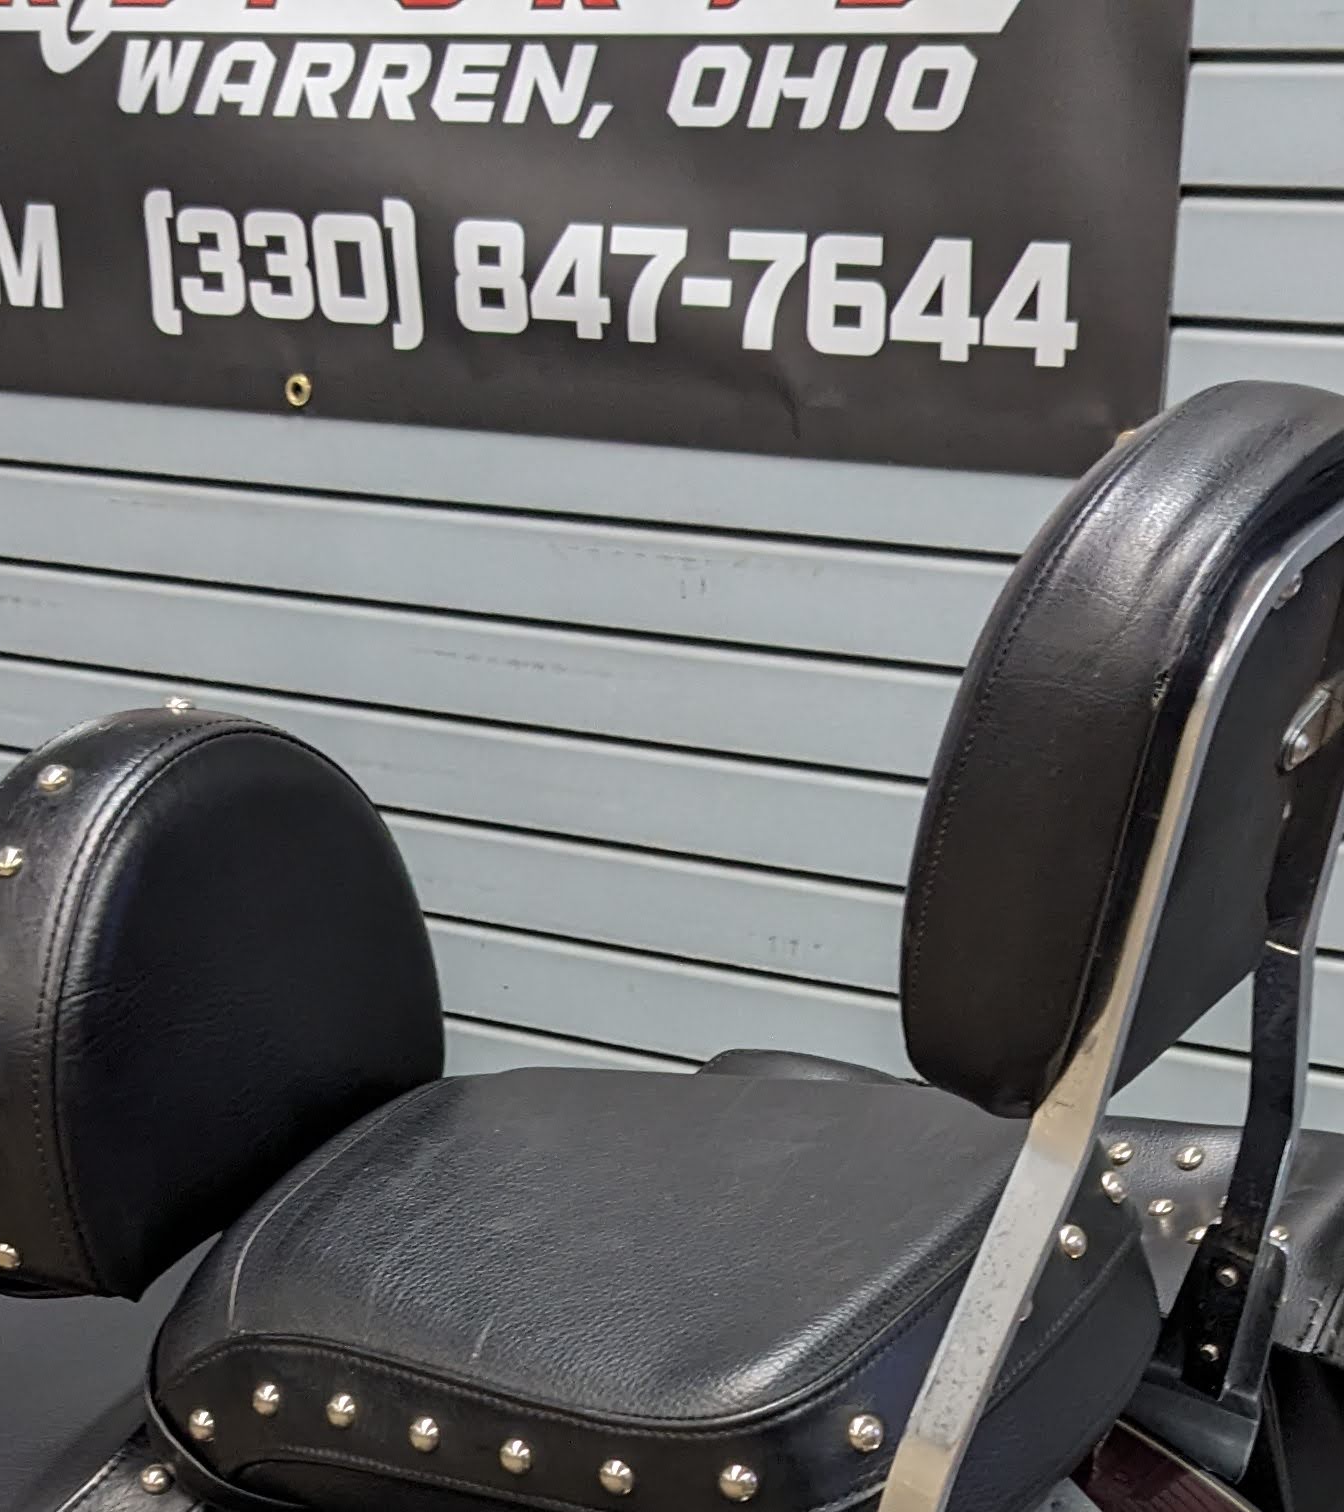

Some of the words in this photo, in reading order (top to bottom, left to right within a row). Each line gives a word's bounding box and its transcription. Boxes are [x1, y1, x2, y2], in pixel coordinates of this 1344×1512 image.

[117, 38, 614, 140] WARREN,
[666, 44, 978, 132] OHIO
[143, 189, 424, 351] (330)
[453, 217, 1079, 368] 847-7644
